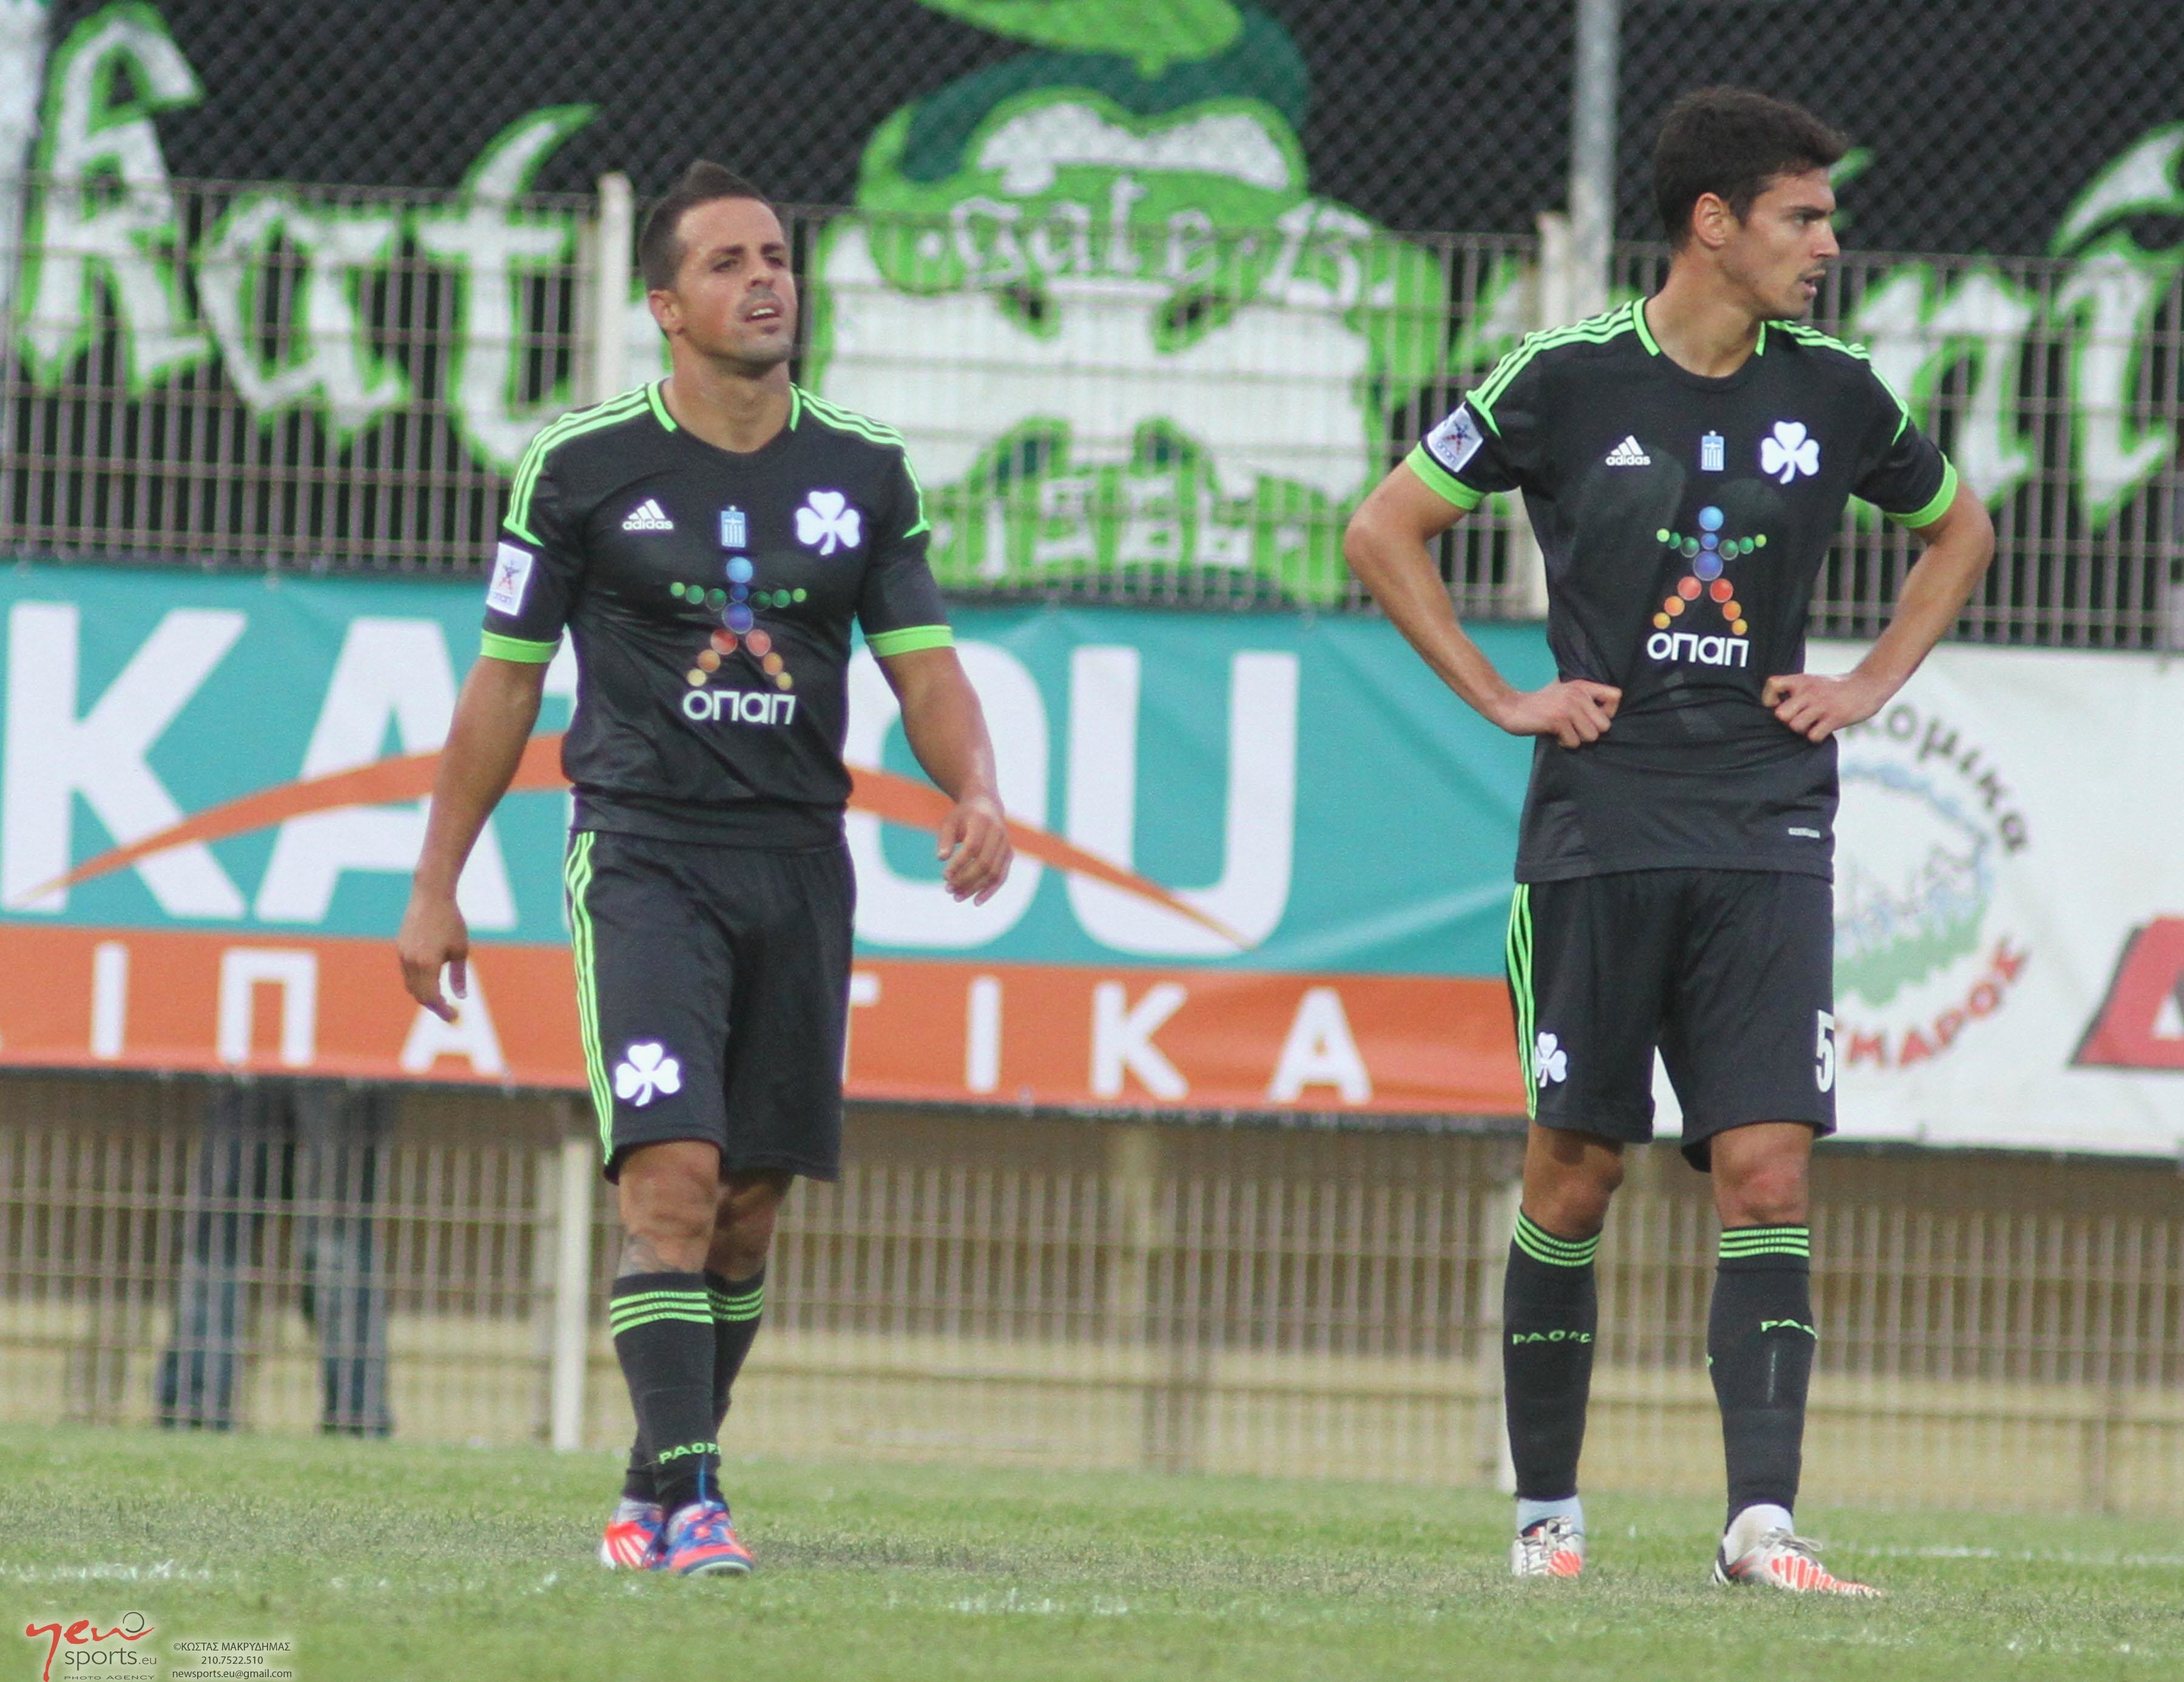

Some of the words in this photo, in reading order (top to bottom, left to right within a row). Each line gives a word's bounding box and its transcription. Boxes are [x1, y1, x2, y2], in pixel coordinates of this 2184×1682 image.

[1605, 454, 1651, 467] adidas
[622, 518, 673, 531] adidas
[0, 602, 1299, 958] KAOU
[1816, 1009, 1834, 1093] 5
